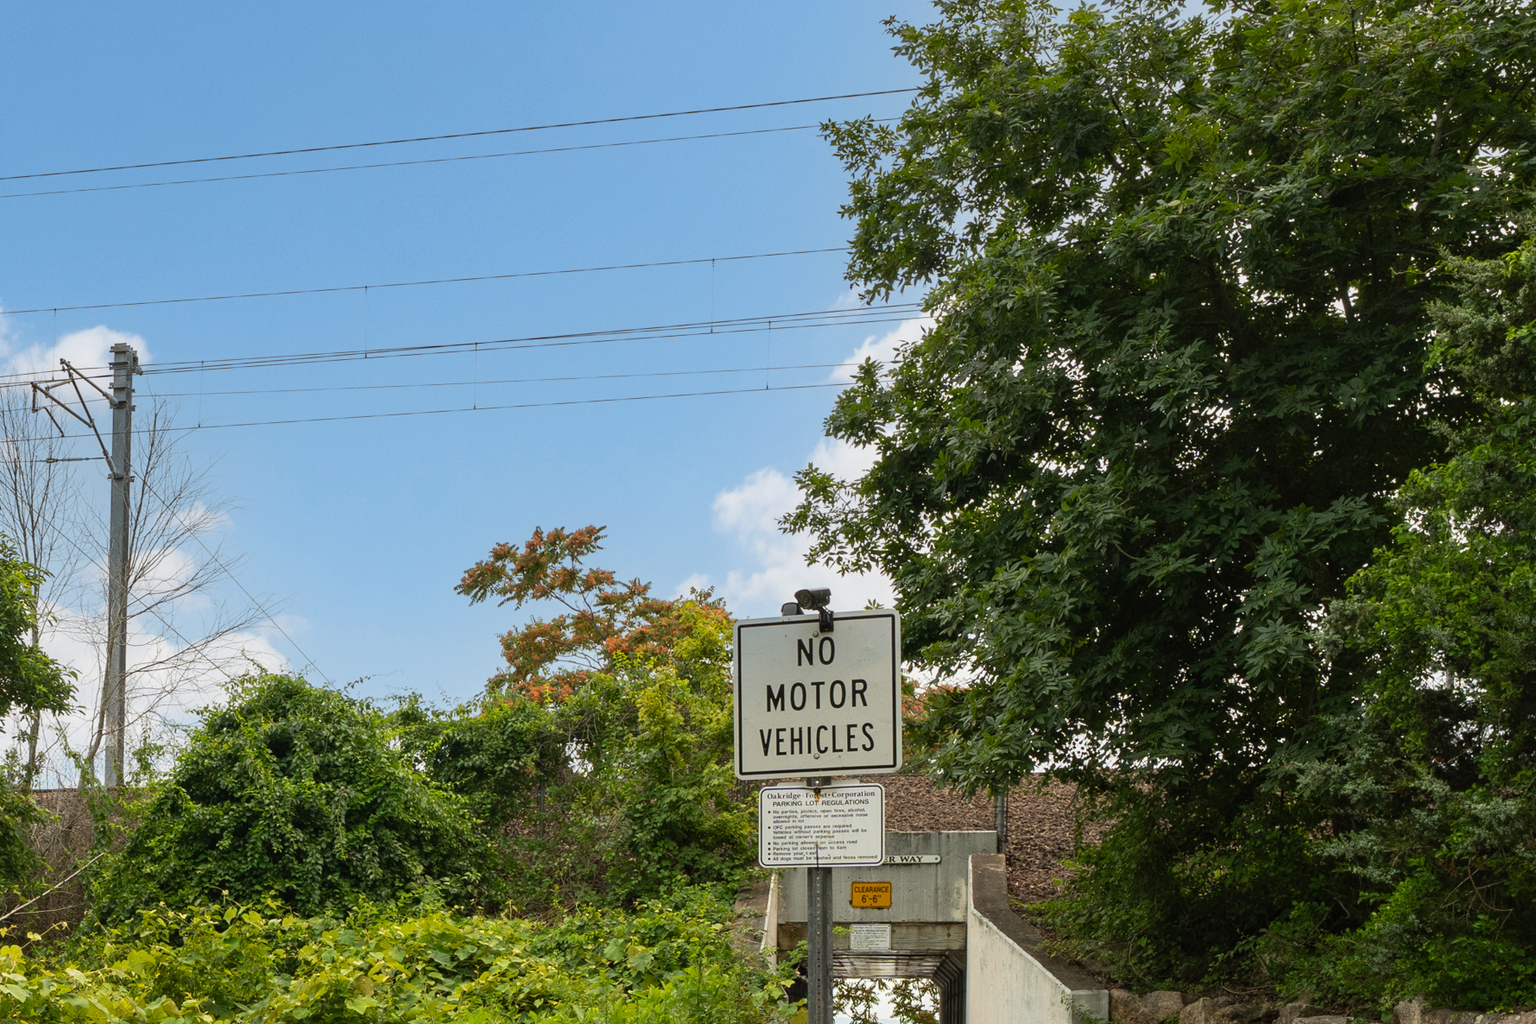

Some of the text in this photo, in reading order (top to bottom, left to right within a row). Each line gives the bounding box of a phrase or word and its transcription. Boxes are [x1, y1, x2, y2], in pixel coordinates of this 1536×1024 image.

[797, 636, 835, 666] NO
[766, 678, 868, 712] MOTOR
[759, 722, 874, 757] VEHICLES
[767, 792, 801, 800] Oakridge
[831, 791, 876, 799] Corporation
[900, 855, 924, 863] WAY
